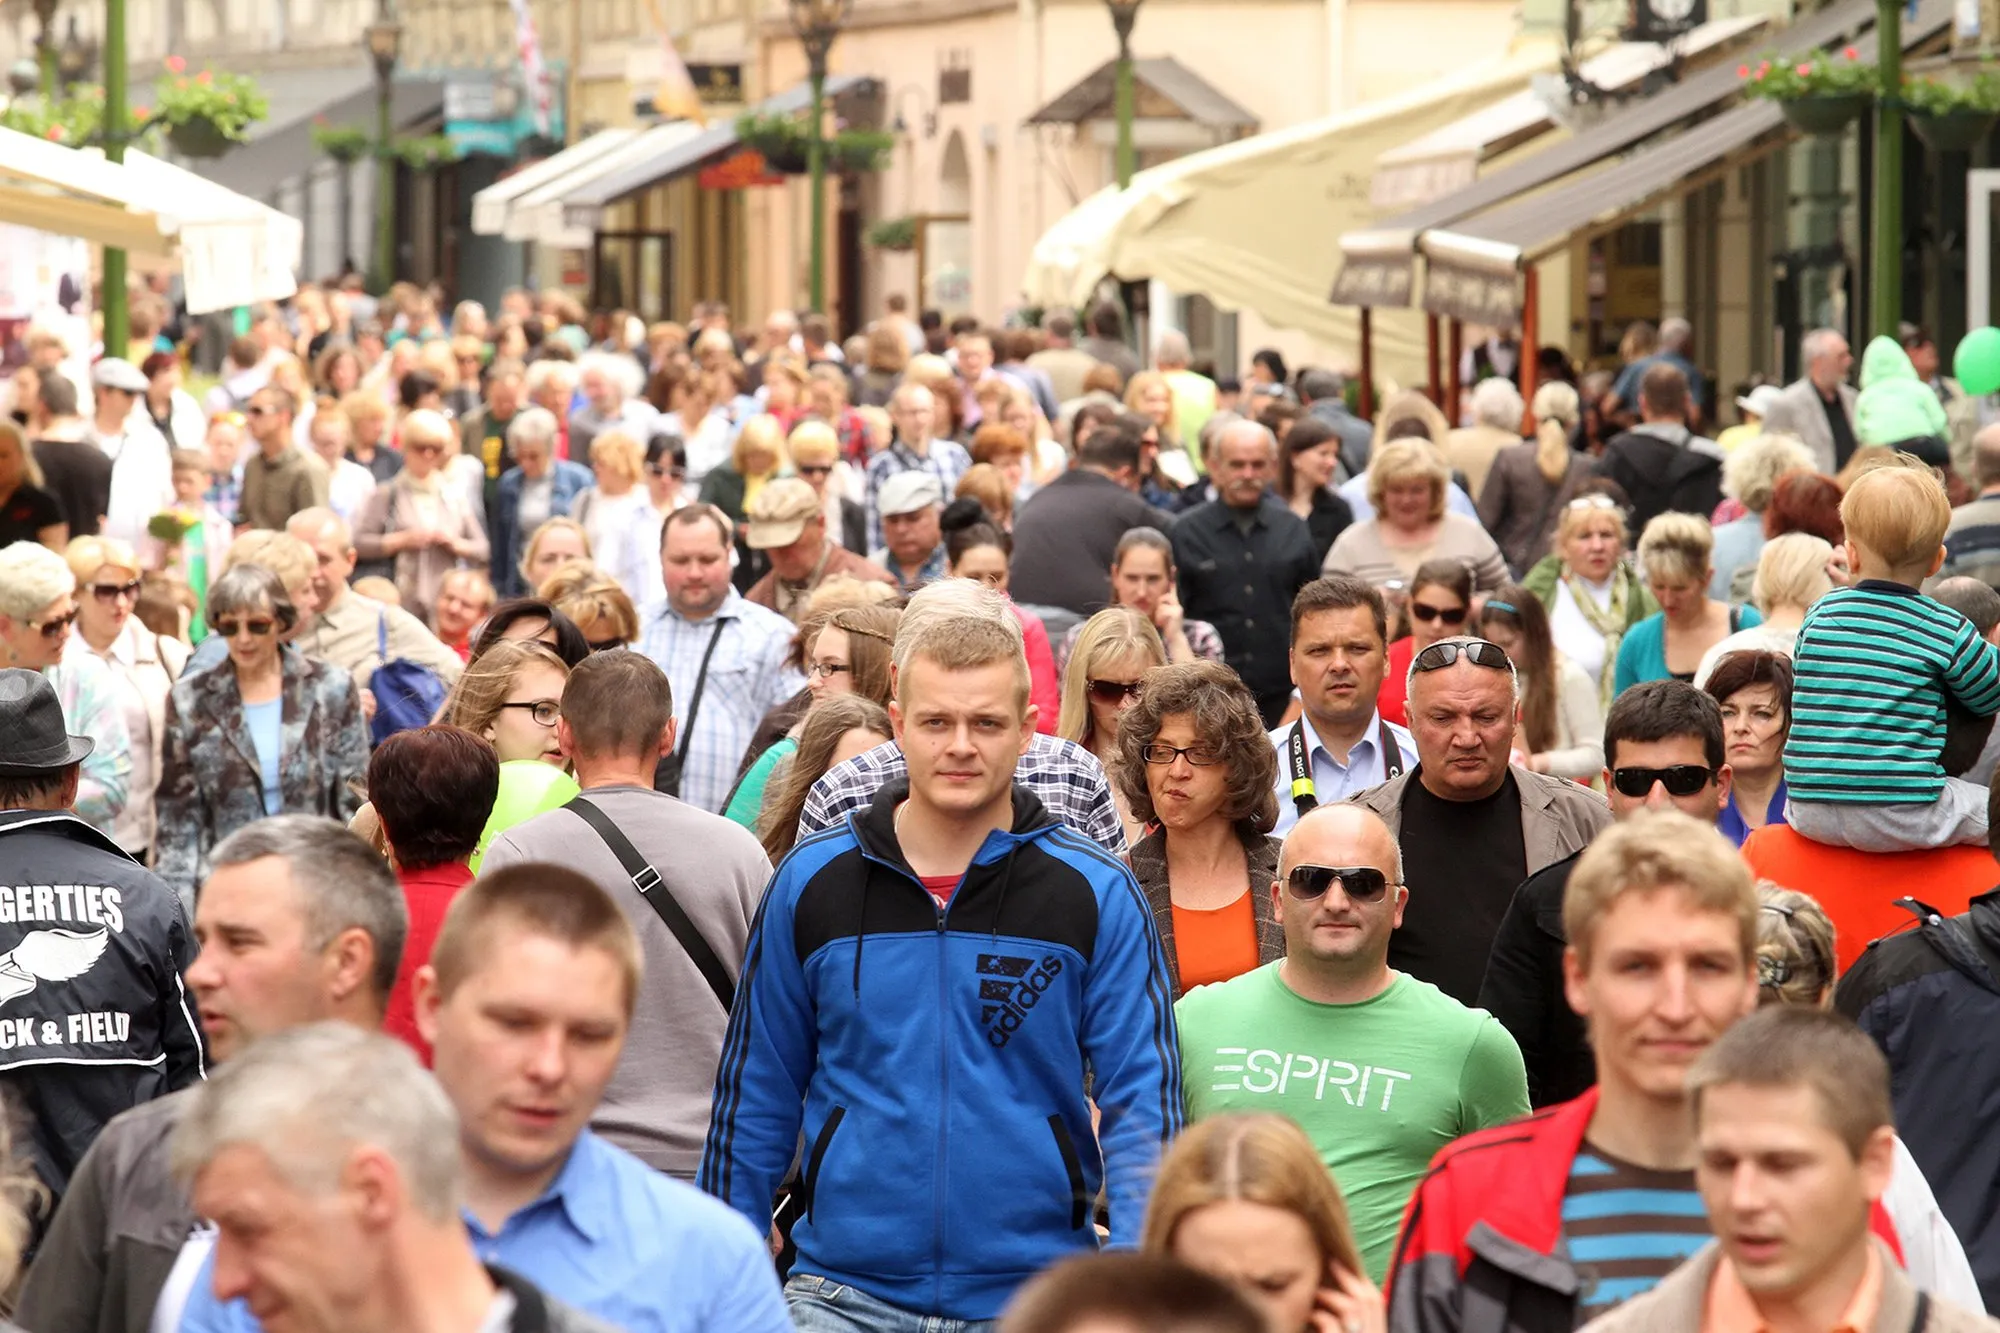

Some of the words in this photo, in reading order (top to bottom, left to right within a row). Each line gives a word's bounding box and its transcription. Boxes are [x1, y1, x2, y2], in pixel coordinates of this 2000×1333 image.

[1293, 734, 1302, 755] EOS
[1295, 756, 1306, 778] DIGI
[0, 885, 124, 934] GERTIES
[988, 955, 1062, 1048] adidas
[0, 1017, 37, 1050] CK
[41, 1020, 63, 1045] &
[67, 1011, 131, 1044] FIELD
[1212, 1048, 1412, 1112] ESPRIT
